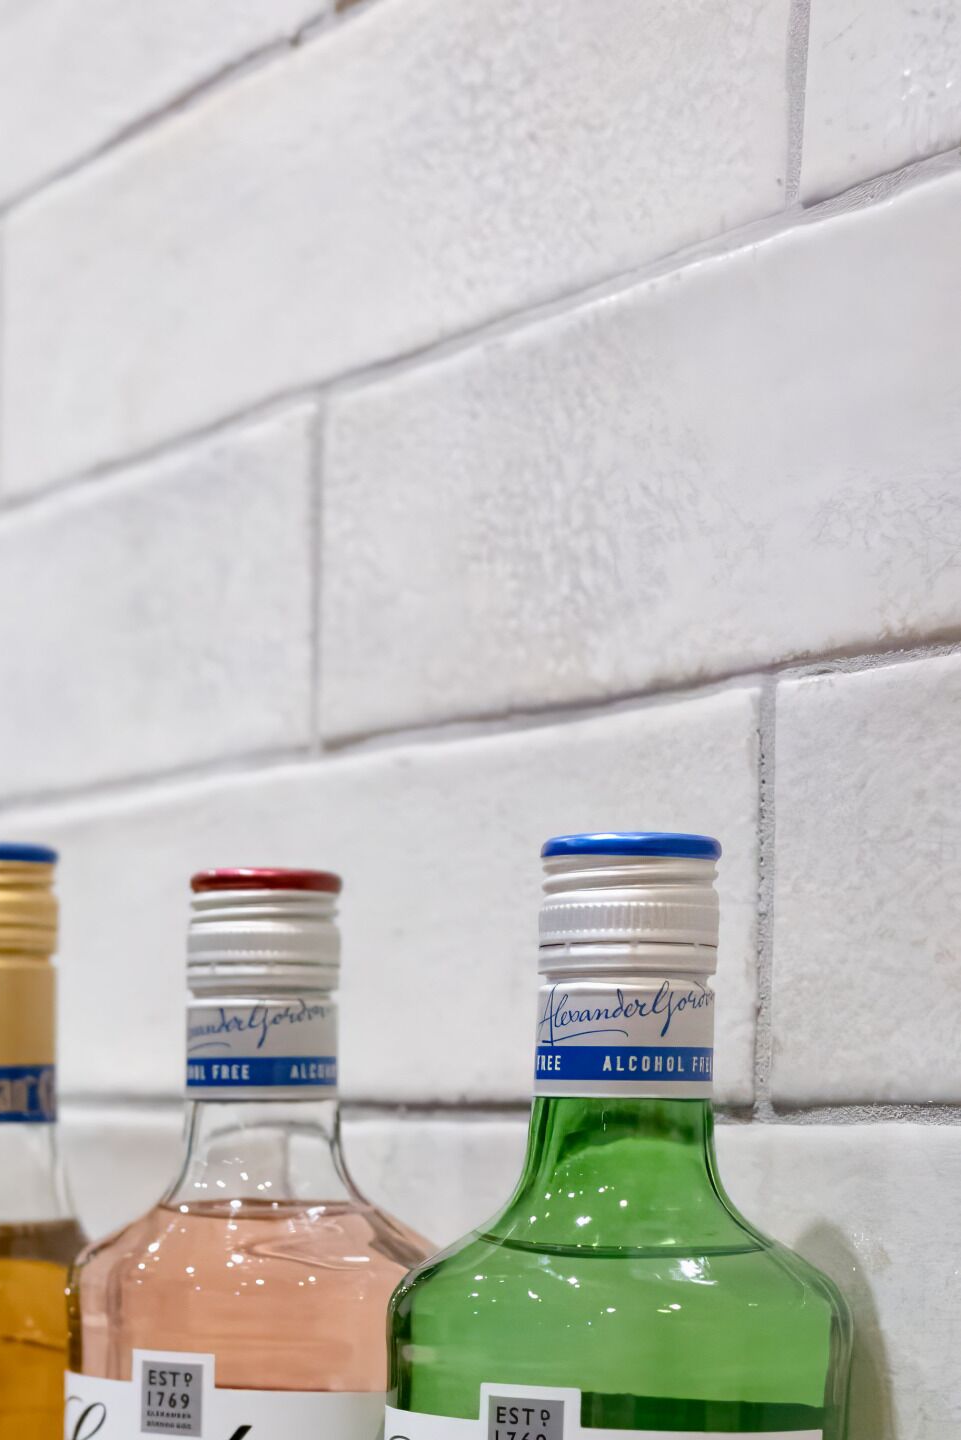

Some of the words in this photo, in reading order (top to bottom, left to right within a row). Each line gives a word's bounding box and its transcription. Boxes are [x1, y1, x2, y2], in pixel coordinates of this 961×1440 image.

[211, 1064, 250, 1080] FREE
[602, 1055, 685, 1072] ALCOHOL
[147, 1390, 190, 1409] 1769
